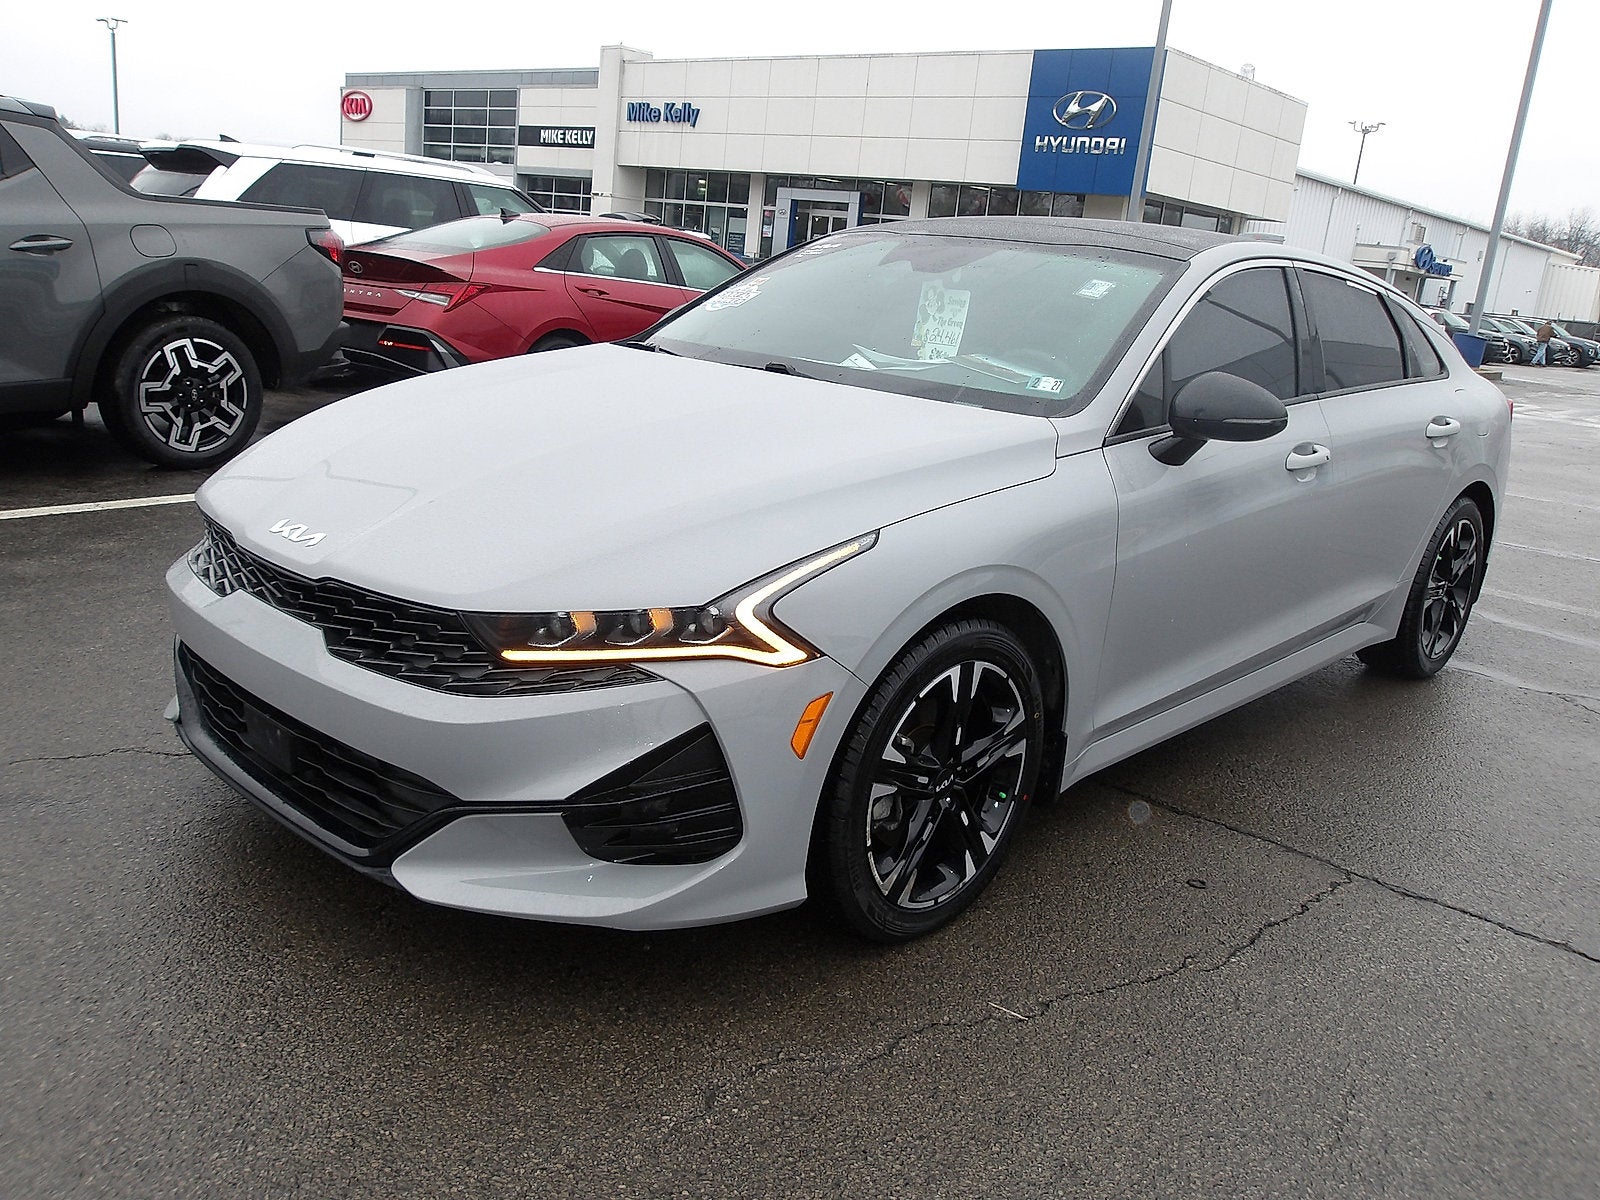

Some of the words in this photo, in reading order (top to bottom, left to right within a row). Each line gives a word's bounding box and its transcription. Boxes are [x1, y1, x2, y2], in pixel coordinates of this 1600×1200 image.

[344, 97, 368, 115] KIA
[627, 102, 661, 123] Mike
[663, 102, 701, 129] Kelly
[540, 129, 564, 144] MIKE
[565, 130, 595, 145] KELLY
[1034, 136, 1127, 155] HYUNDAI
[1051, 380, 1063, 391] 27
[268, 519, 327, 547] KIA
